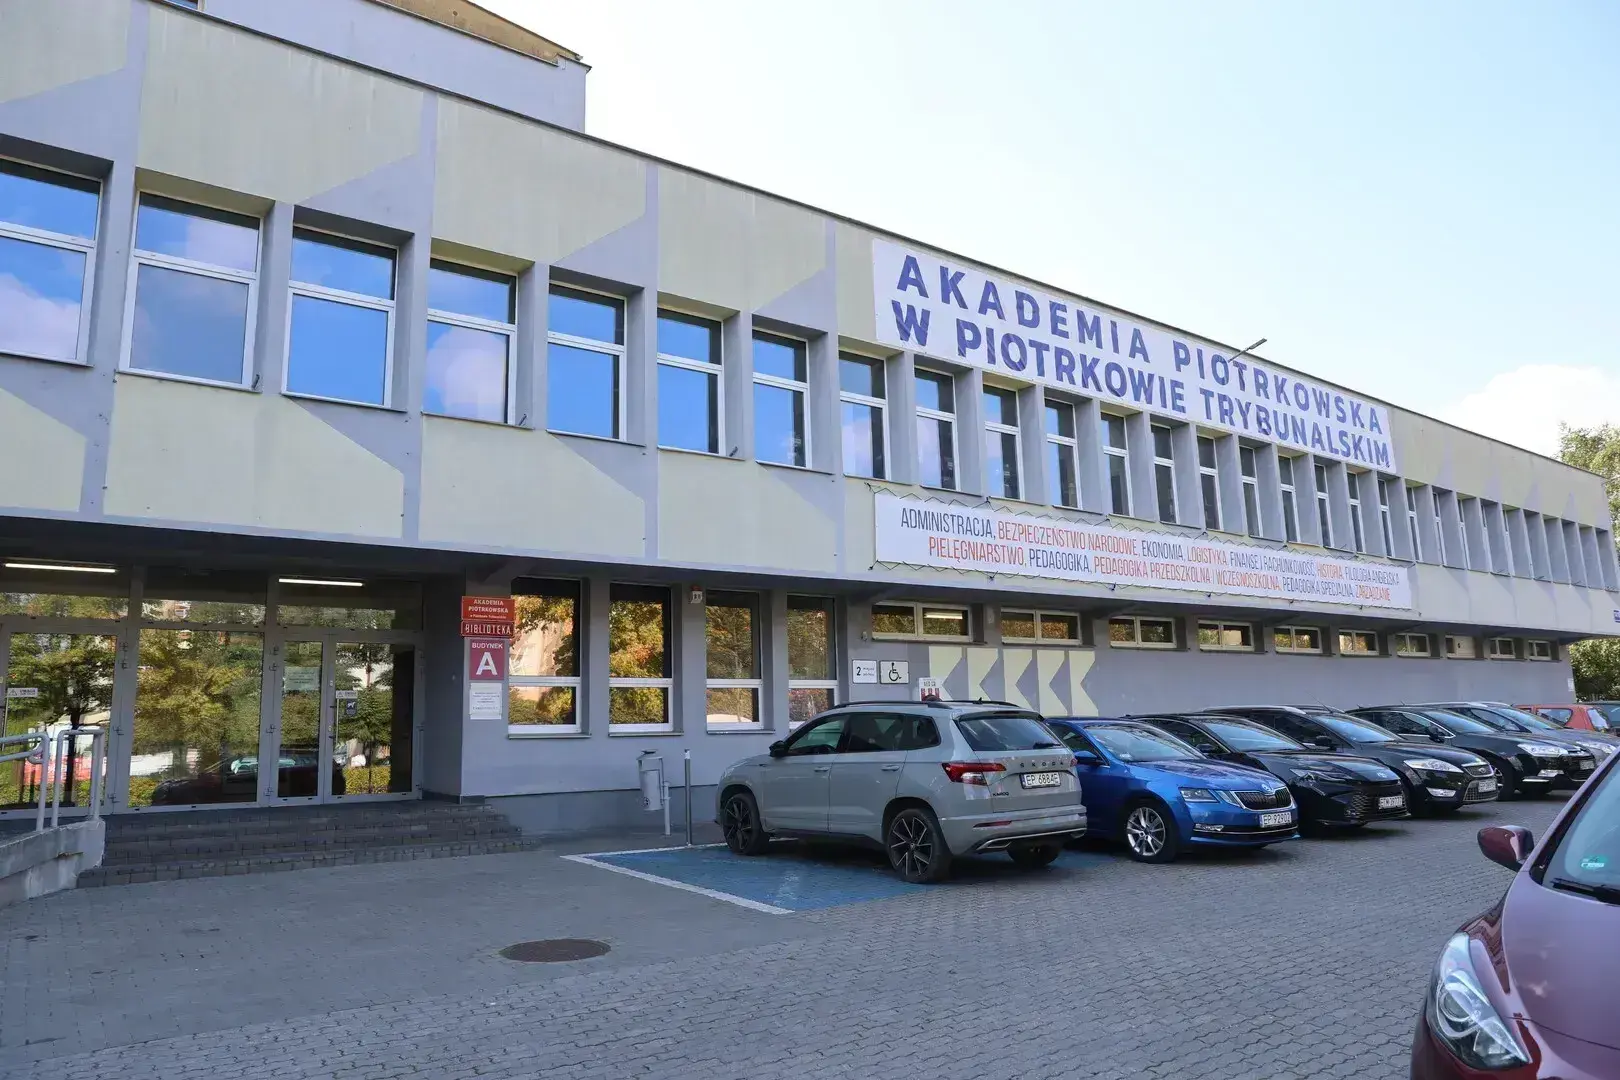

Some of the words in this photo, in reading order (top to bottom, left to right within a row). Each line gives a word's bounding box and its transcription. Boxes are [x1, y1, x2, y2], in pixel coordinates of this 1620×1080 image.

[897, 255, 1151, 362] AKADEMIA
[1173, 340, 1383, 434] PIOTRKOWSKA
[892, 300, 930, 347] W
[956, 318, 1185, 414] PIOTRKOWIE
[1199, 388, 1391, 468] TRYBUNALSKIM
[901, 507, 996, 540] ADMINISTRACJA,
[998, 520, 1085, 550] BEZPIECZEŃSTWO
[1088, 533, 1140, 557] NARODOWE,
[1142, 540, 1185, 562] EKONOMIA,
[1230, 551, 1259, 570] FINANSE
[929, 536, 1027, 567] PIELĘGNIARSTWO,
[1029, 548, 1092, 574] PEDAGOGIKA,
[1094, 555, 1148, 579] PEDAGOGIKA
[1150, 562, 1210, 583] PRZEDSZKOLNA
[1282, 578, 1320, 595] PEDAGOGIKA
[465, 623, 511, 635] BIBLIOTEKA
[468, 605, 509, 613] PIOTRKOWSKA
[476, 652, 498, 675] A
[856, 666, 861, 676] 2
